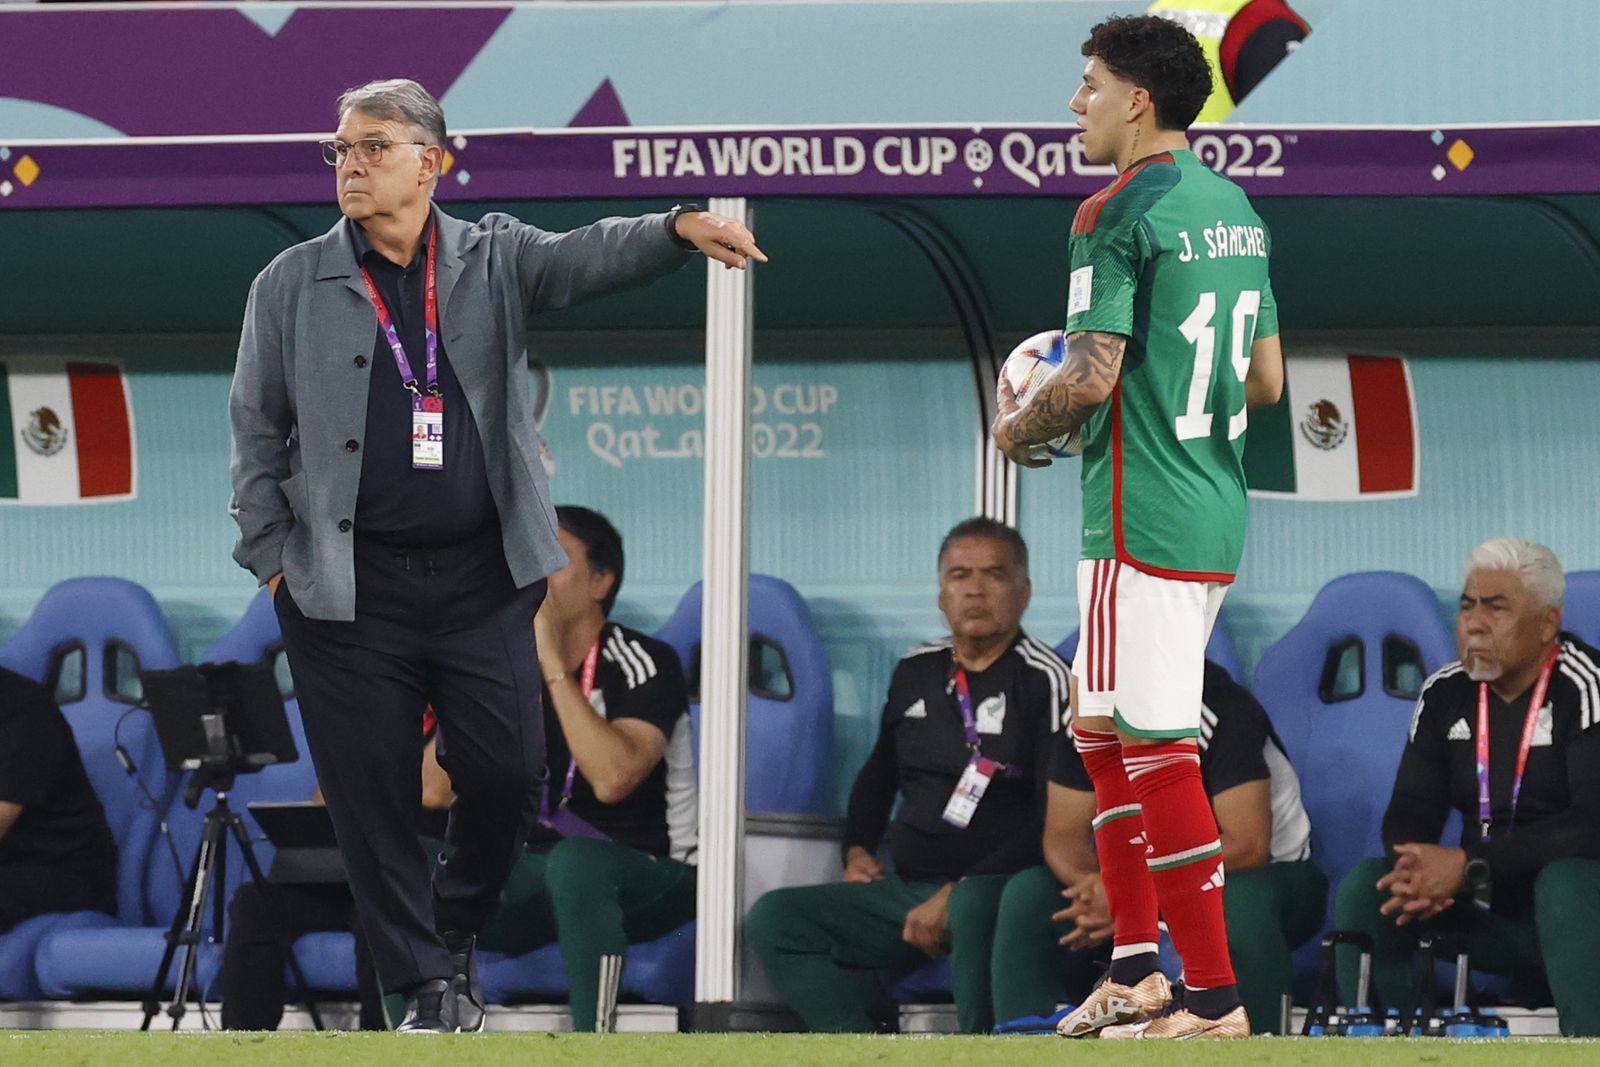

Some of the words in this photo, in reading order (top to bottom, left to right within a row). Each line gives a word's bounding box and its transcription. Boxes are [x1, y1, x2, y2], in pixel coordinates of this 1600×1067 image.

[612, 138, 706, 178] FIFA
[707, 136, 867, 177] WORLD
[873, 136, 958, 176] CUP
[1000, 132, 1118, 188] Qat
[1192, 134, 1285, 177] 022
[1178, 231, 1200, 262] J.
[1203, 220, 1267, 259] SÁNCHE
[568, 385, 642, 416] FIFA
[642, 384, 768, 416] WOD
[773, 384, 839, 415] CUP
[586, 422, 706, 469] Qata
[751, 422, 826, 459] 022
